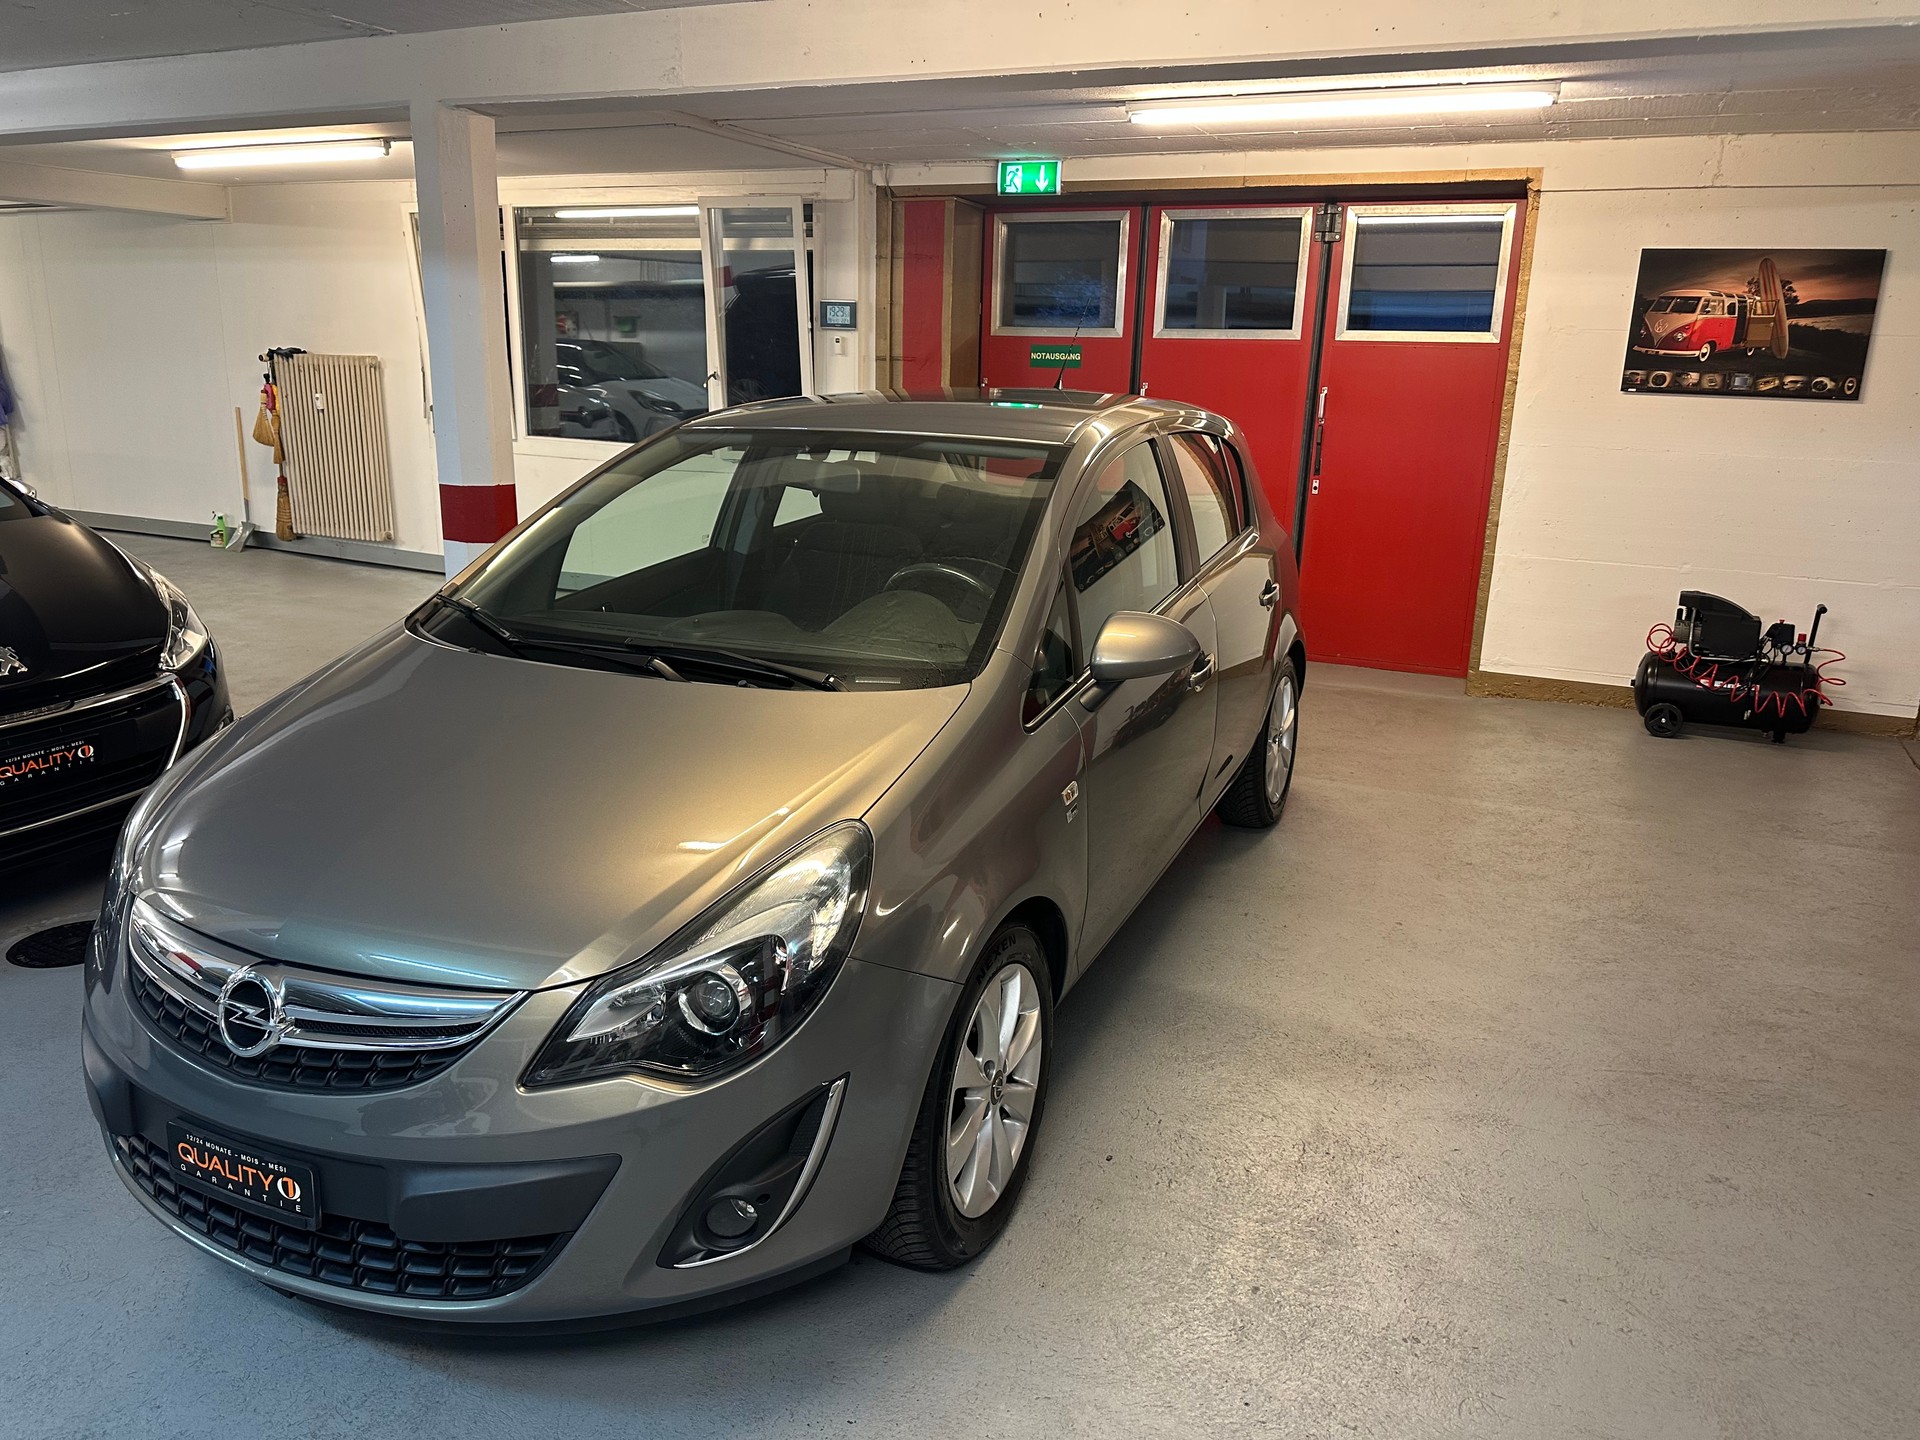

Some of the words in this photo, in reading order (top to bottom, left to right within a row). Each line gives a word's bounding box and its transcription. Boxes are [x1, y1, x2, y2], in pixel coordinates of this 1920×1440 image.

[1031, 352, 1081, 361] NOTAUSGANG
[0, 749, 76, 779] QUALITY
[0, 757, 94, 786] GARANTIE
[22, 749, 45, 759] MONATE
[976, 934, 1016, 985] NEXEN
[177, 1142, 275, 1192] QUALITY
[186, 1133, 204, 1145] 12/24
[205, 1142, 232, 1156] MONATE
[241, 1153, 259, 1165] MOIS
[268, 1162, 287, 1173] MESI
[180, 1163, 302, 1212] GARANTIE
